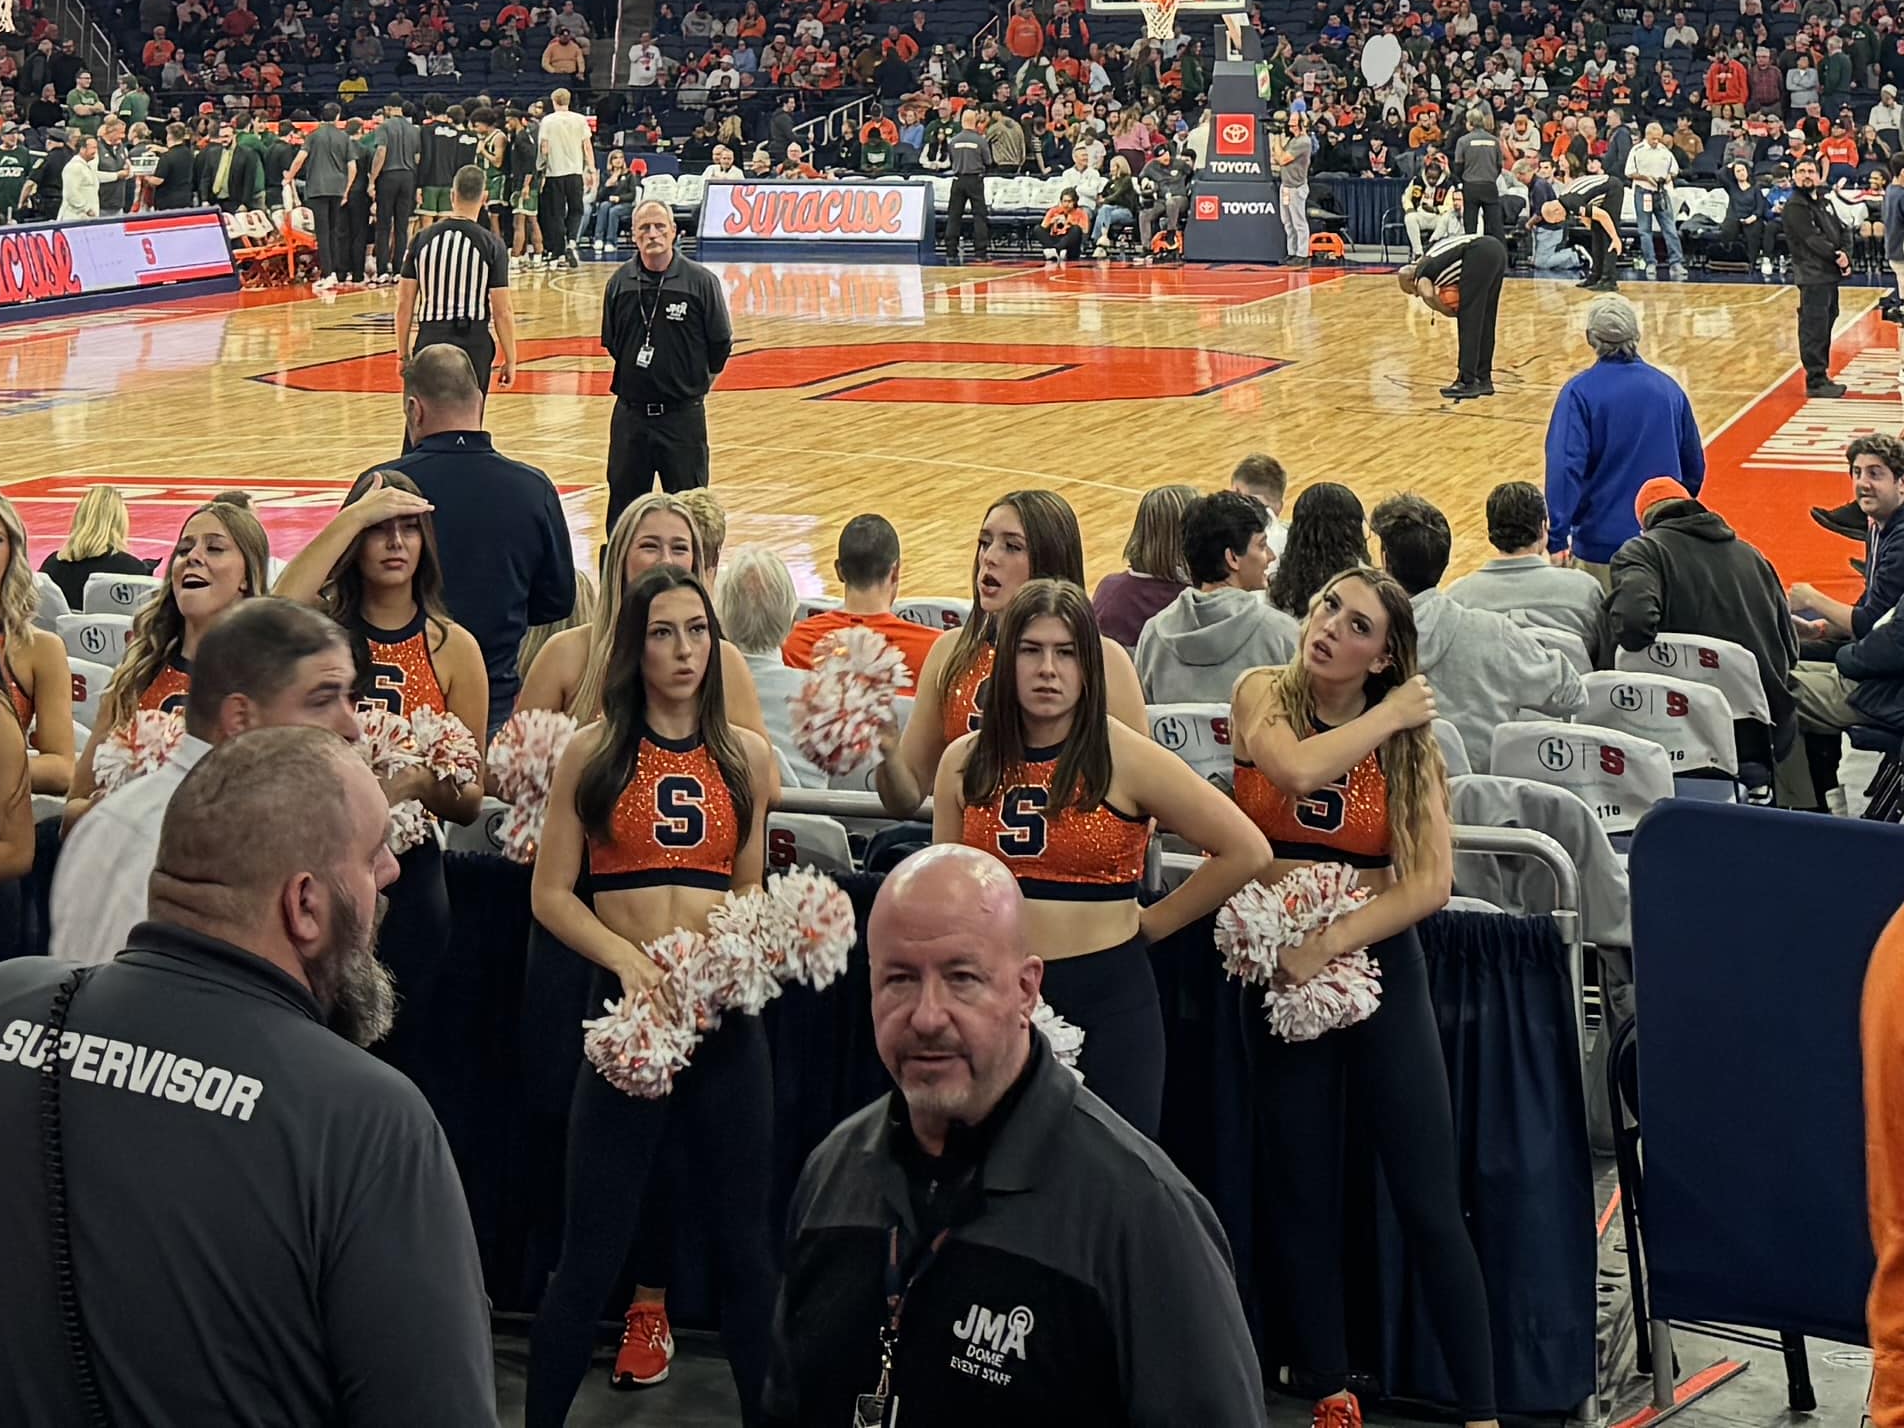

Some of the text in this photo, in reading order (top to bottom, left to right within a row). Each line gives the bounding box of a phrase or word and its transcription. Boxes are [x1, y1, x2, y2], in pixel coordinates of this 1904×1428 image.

[1210, 161, 1261, 174] TOYOTA
[724, 183, 902, 240] Syracuse
[1221, 201, 1275, 215] TOYOTA
[142, 238, 156, 265] S
[653, 775, 706, 849] S
[997, 786, 1050, 859] S
[1596, 805, 1621, 819] 116
[953, 1304, 1035, 1361] JMA
[966, 1344, 1005, 1368] DOME
